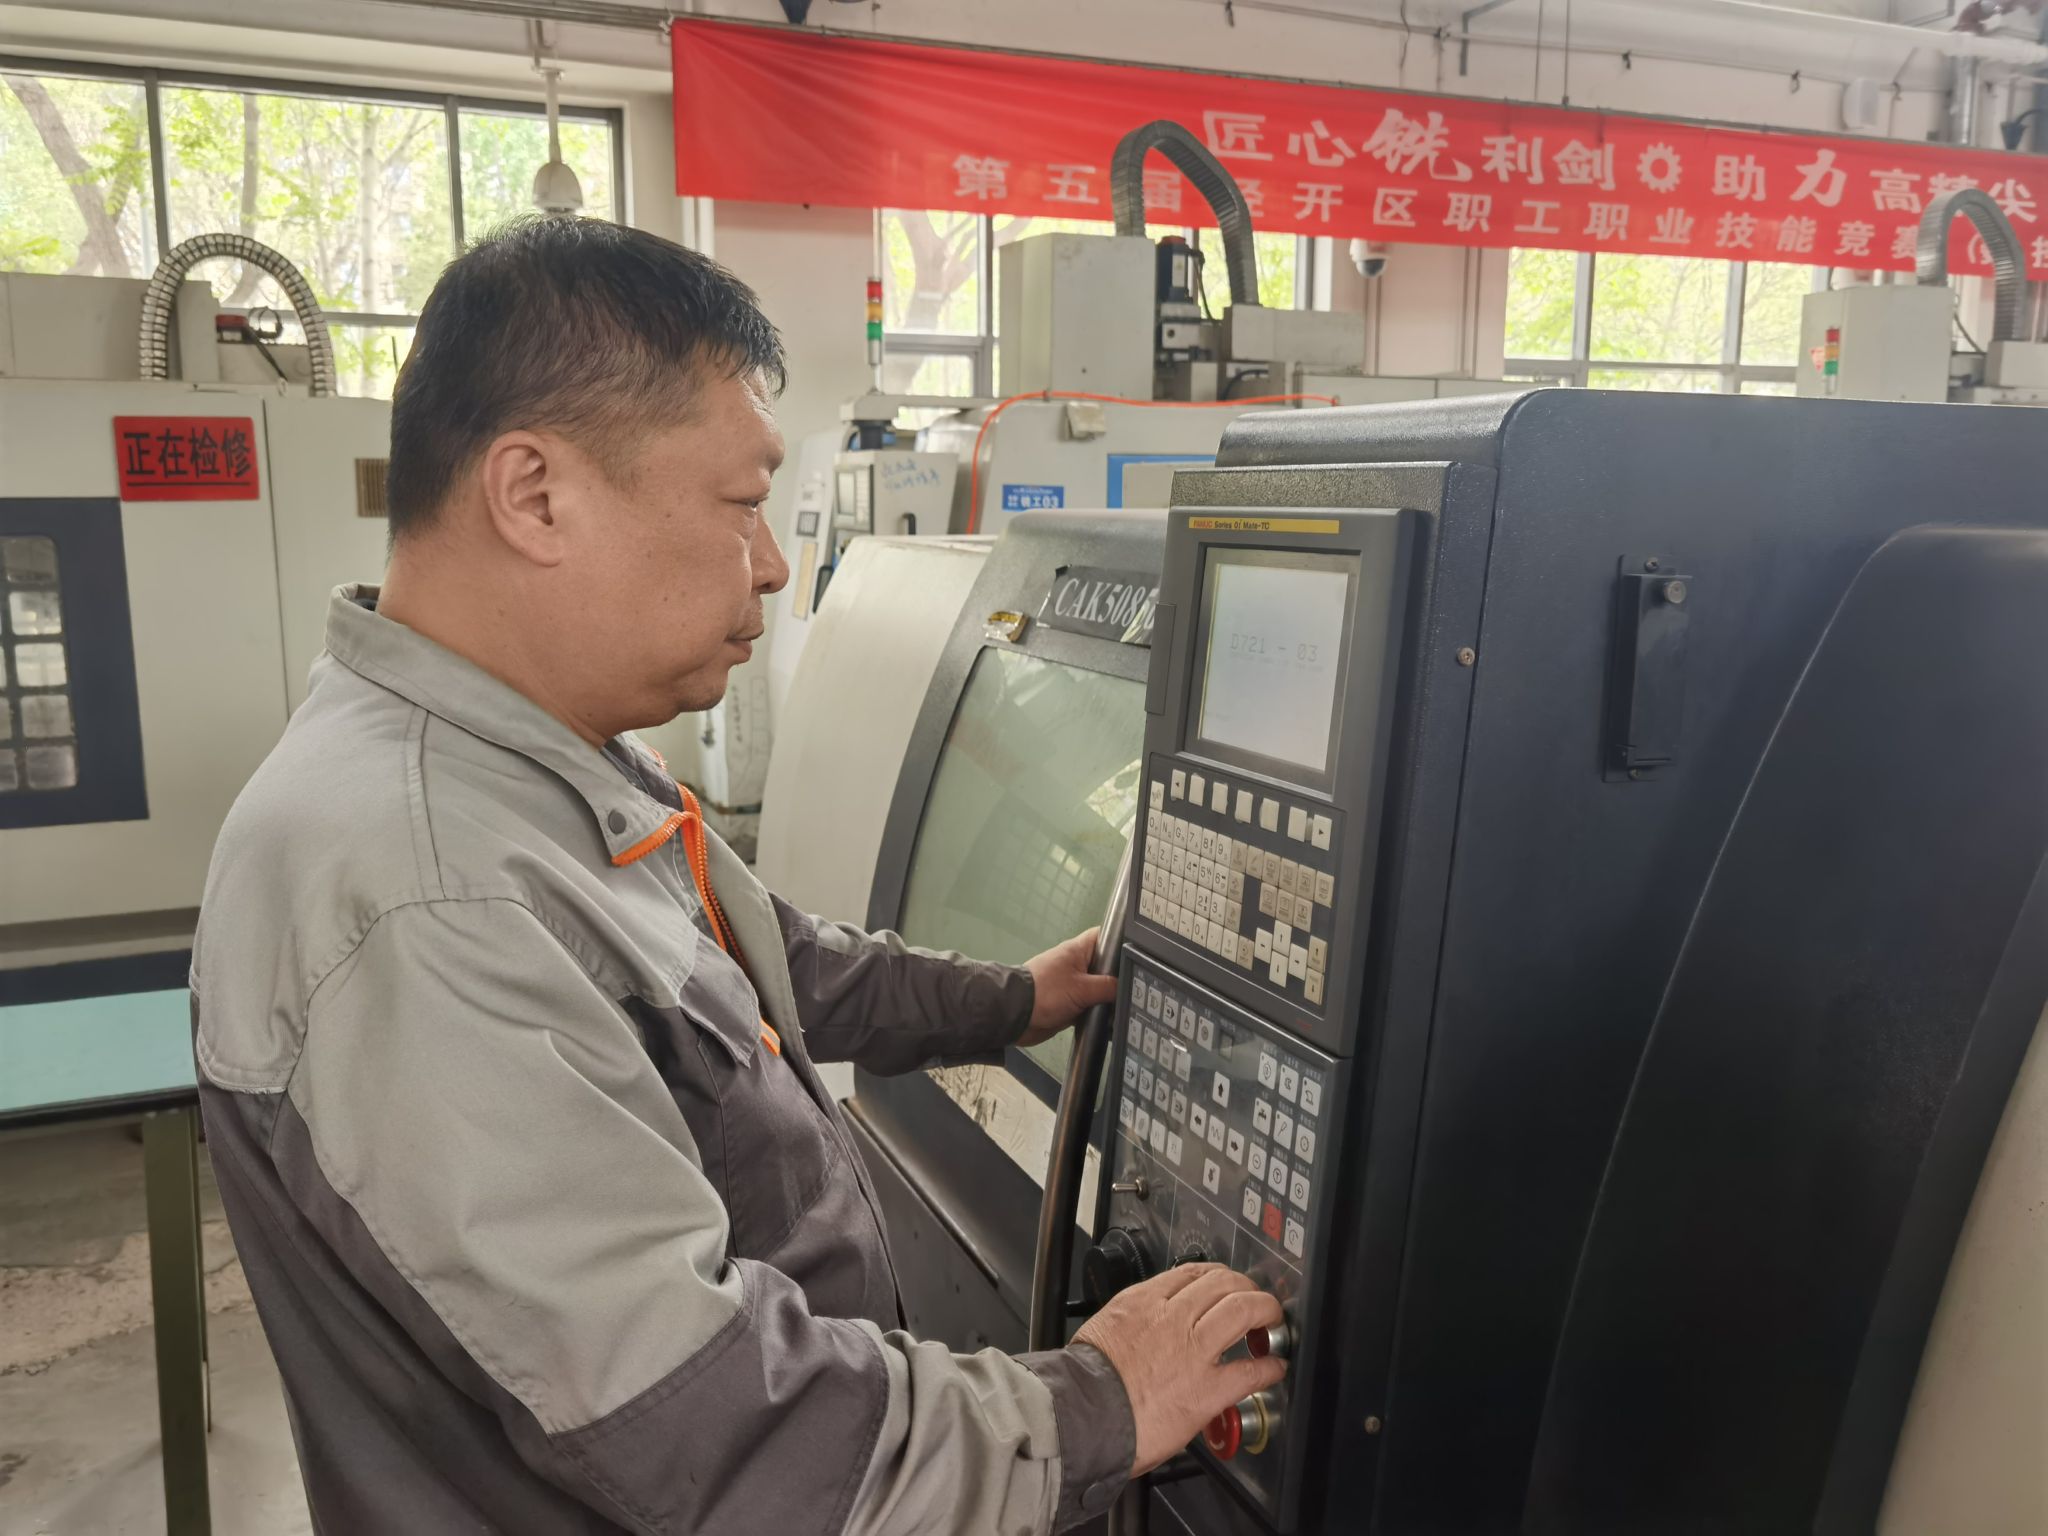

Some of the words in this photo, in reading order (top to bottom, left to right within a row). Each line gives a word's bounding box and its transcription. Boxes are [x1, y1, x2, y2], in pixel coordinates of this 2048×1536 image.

[1203, 107, 1617, 192] 匠心铣利剑
[123, 427, 253, 479] 正在检修
